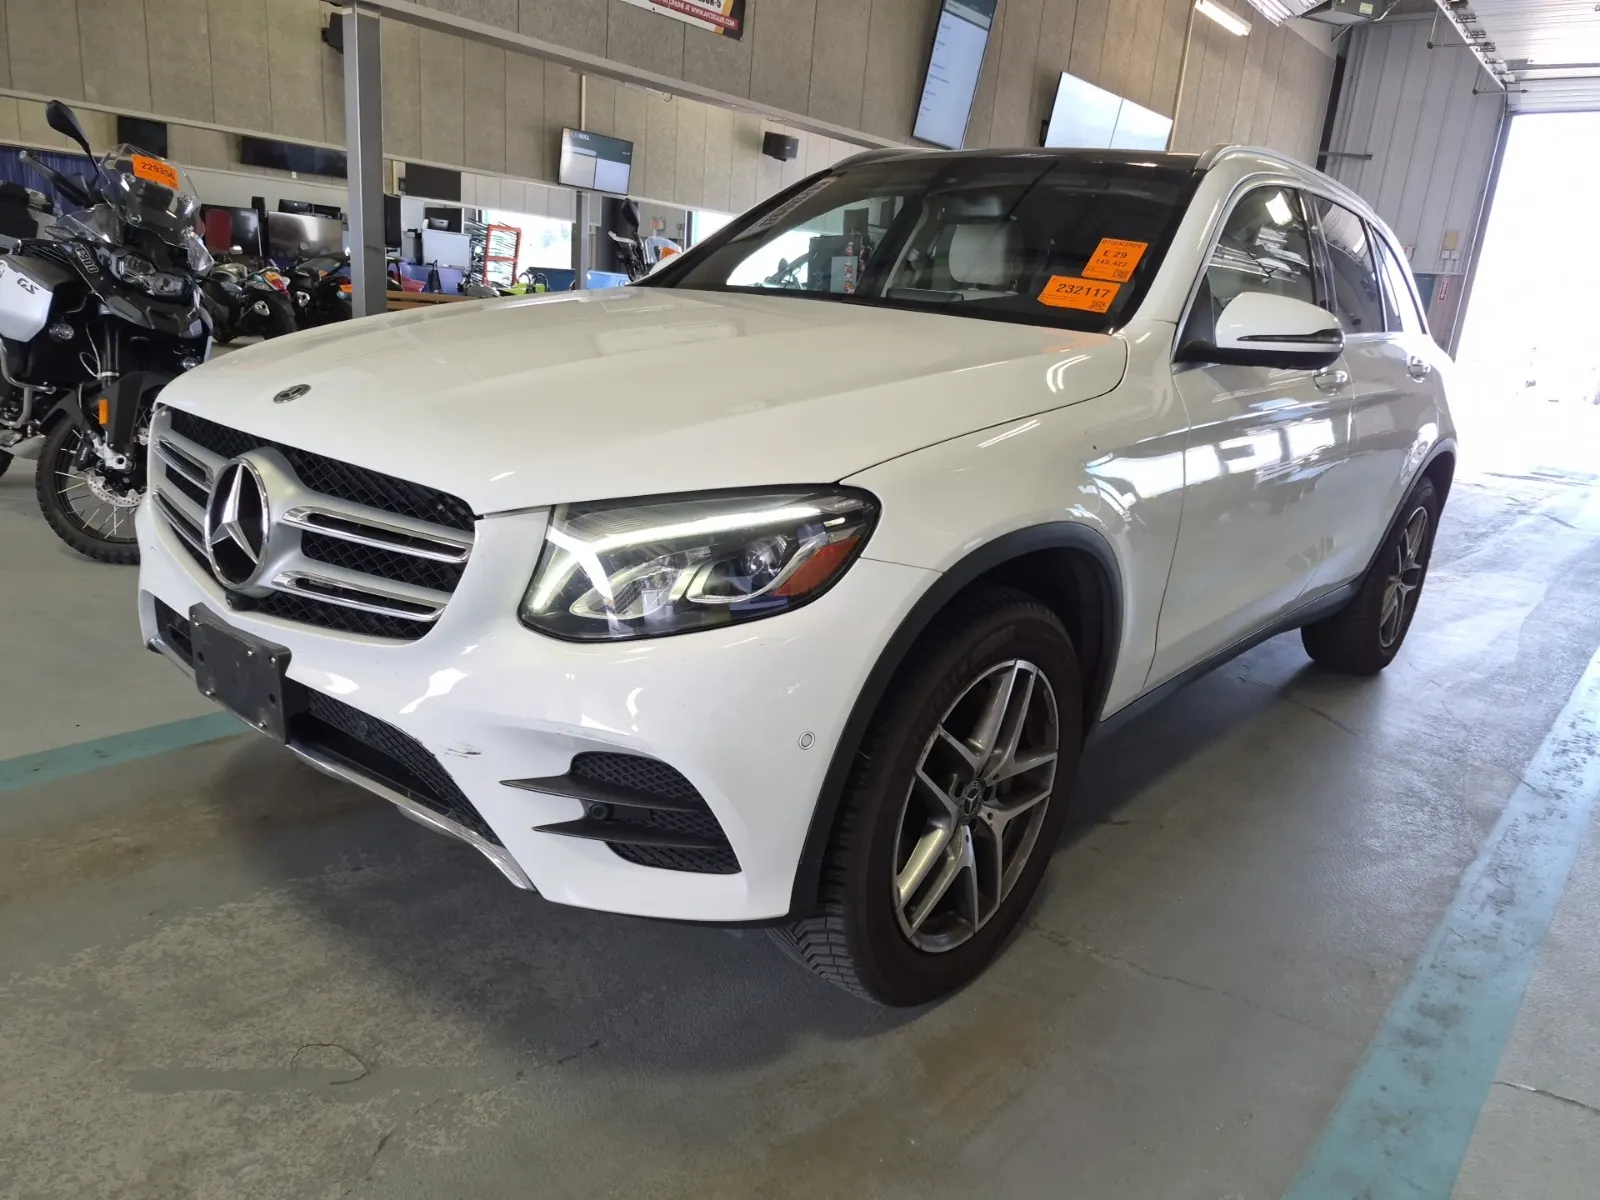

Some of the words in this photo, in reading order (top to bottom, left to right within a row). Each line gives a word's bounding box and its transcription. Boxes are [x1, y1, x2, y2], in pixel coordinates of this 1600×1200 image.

[1113, 251, 1128, 259] 29
[17, 278, 40, 294] GS
[1056, 283, 1111, 298] 232117
